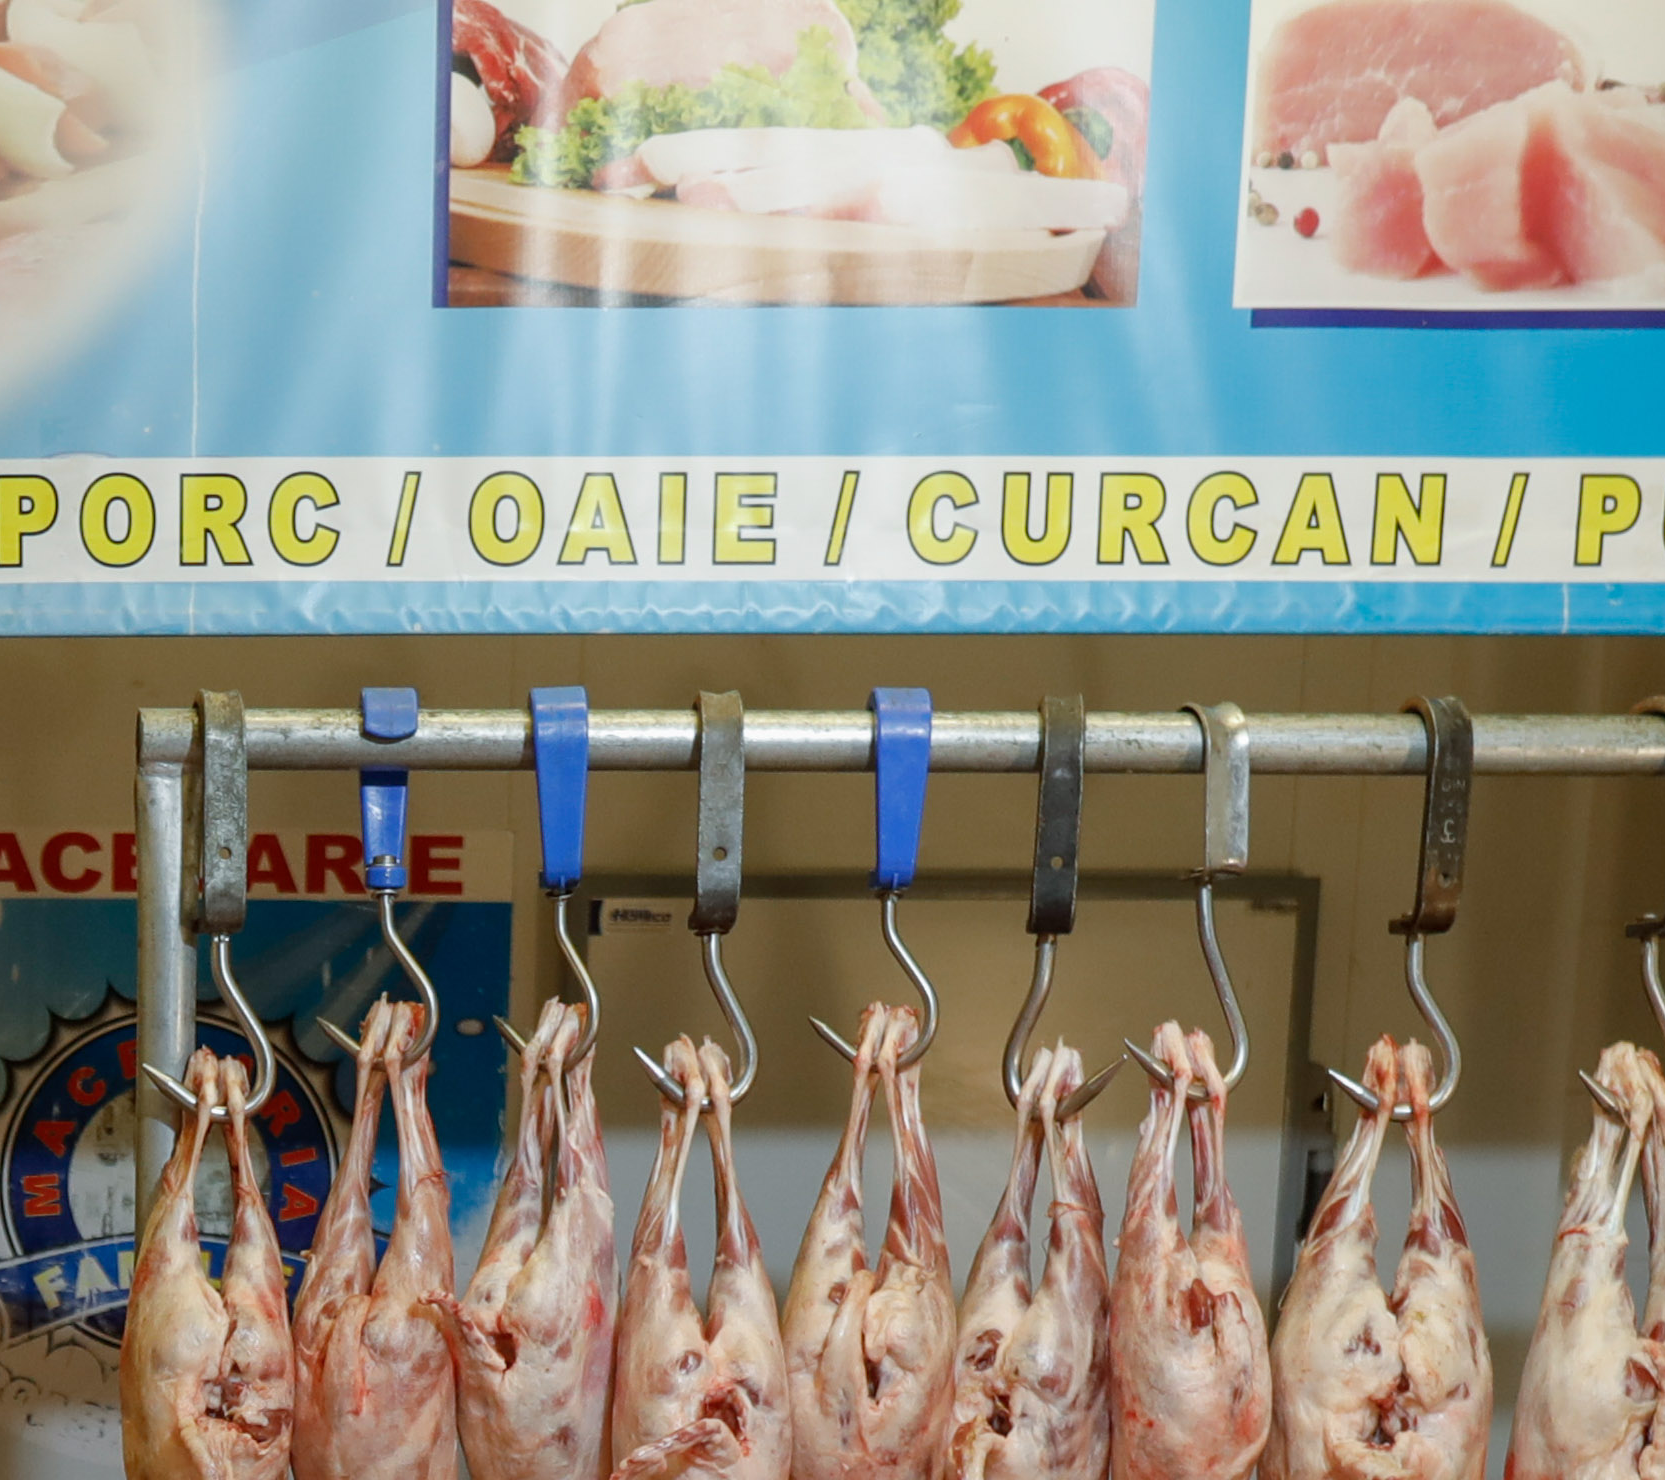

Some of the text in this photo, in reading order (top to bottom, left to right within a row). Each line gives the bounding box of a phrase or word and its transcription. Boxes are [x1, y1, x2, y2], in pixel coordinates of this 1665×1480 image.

[386, 471, 422, 568] /
[468, 470, 777, 566] OAIE
[824, 470, 860, 566] /
[905, 469, 1447, 568] CURCAN
[1490, 472, 1531, 567] /
